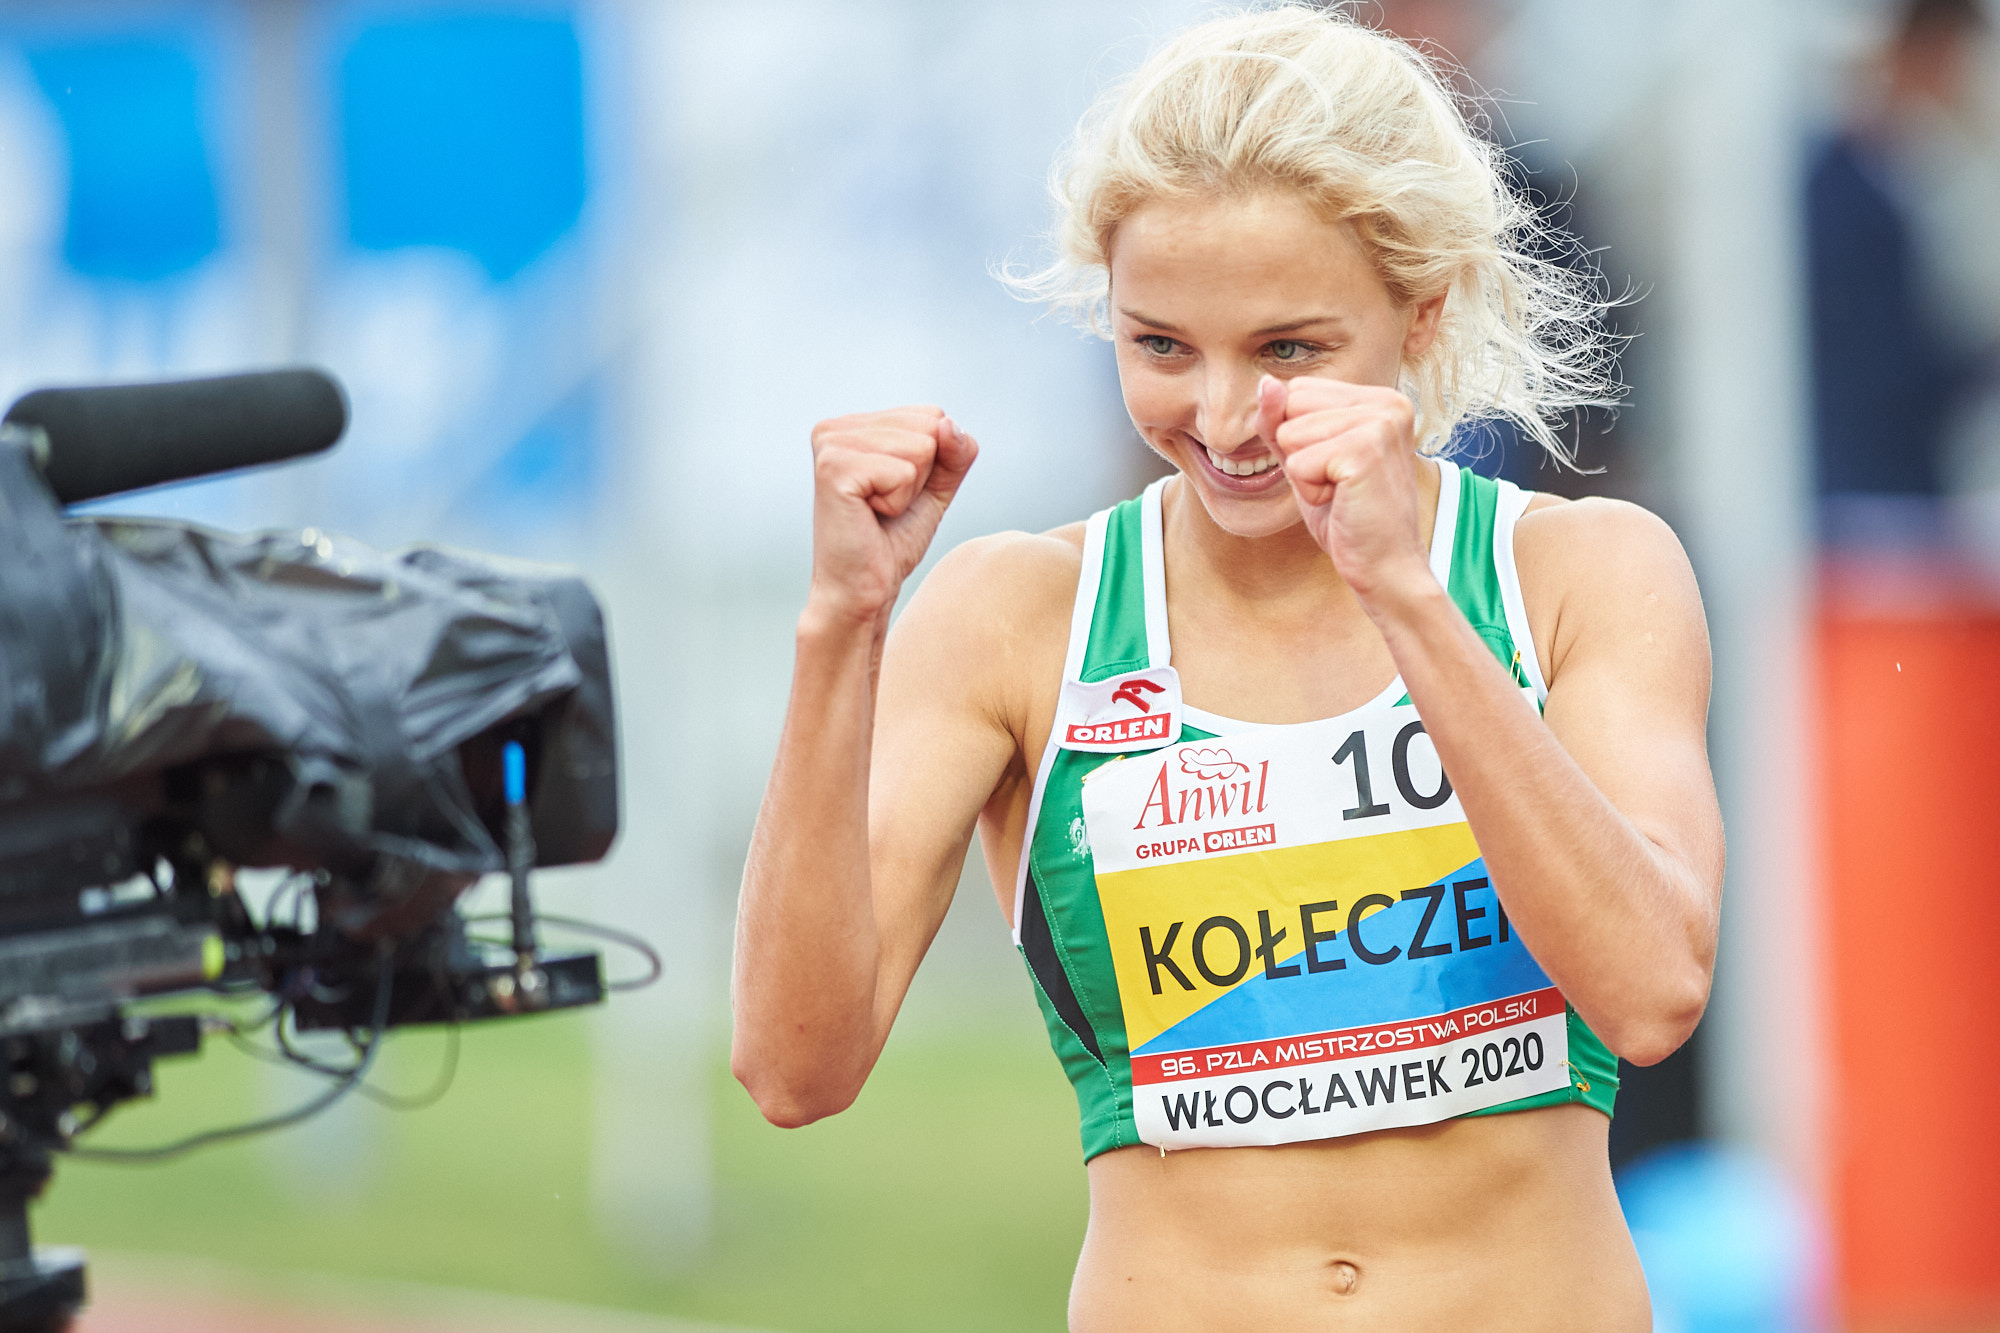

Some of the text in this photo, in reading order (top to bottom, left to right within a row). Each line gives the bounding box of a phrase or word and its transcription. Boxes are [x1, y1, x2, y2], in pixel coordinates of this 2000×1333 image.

[1073, 716, 1164, 742] ORLEN
[1133, 758, 1270, 830] Anwil
[1331, 720, 1455, 821] 10
[1136, 826, 1273, 860] GRUPA ORLEN
[1161, 998, 1538, 1077] 96. PZLA MISTRZOSTWA POLSKI
[1161, 1032, 1545, 1132] WŁOCŁAWEK 2020
